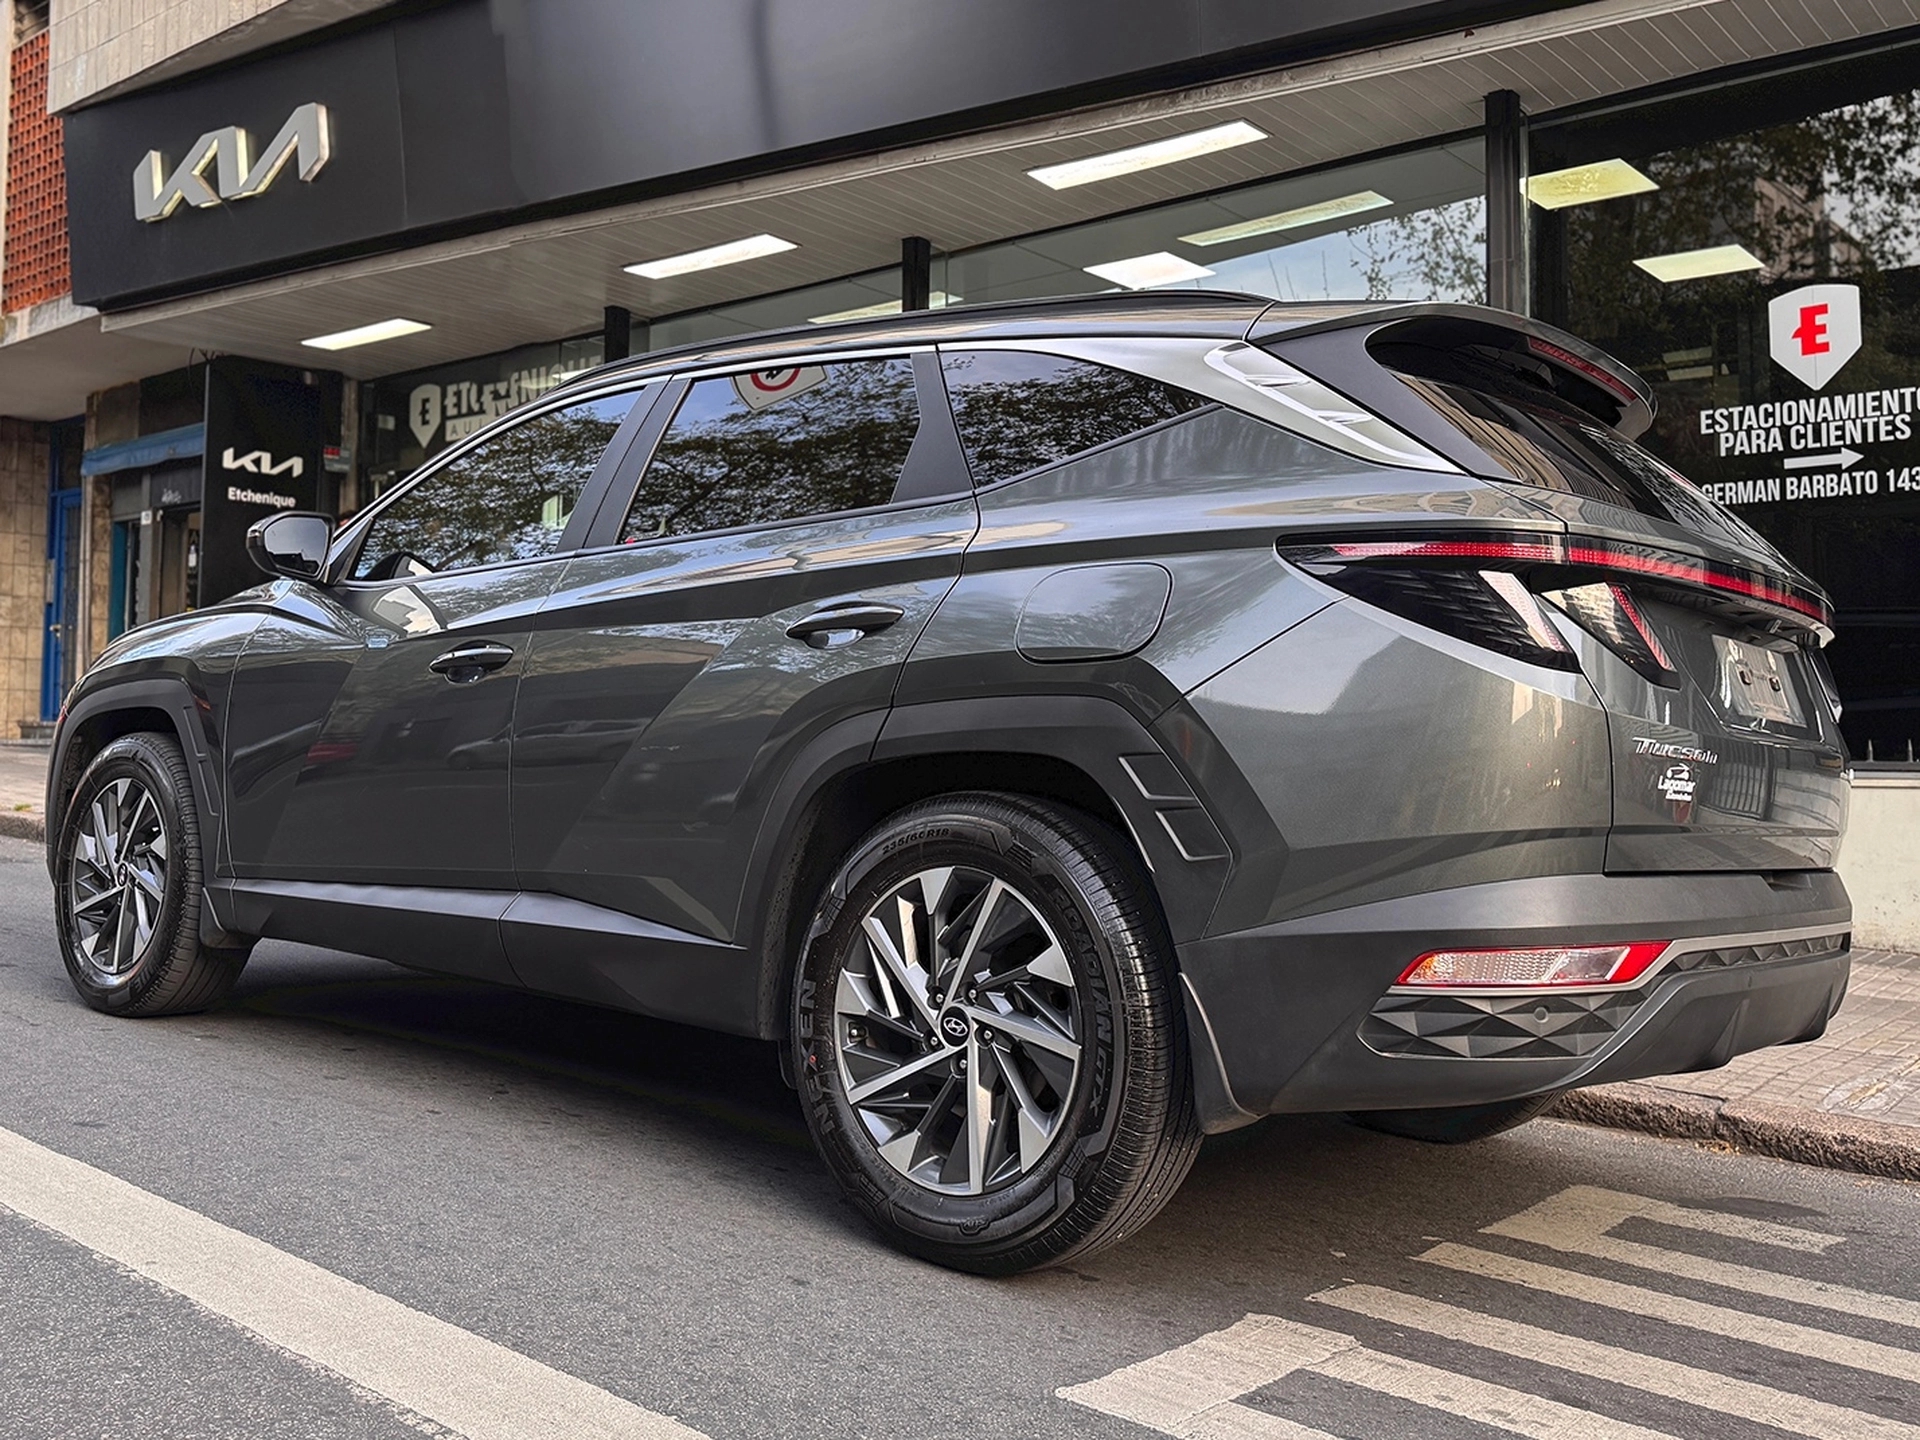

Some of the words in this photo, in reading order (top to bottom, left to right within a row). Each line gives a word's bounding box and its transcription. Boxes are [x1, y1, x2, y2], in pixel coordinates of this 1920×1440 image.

[133, 102, 330, 222] KIA
[1791, 303, 1831, 356] E
[1700, 387, 1920, 435] ESTACIONAMIENT
[1719, 427, 1784, 457] PARA
[1790, 413, 1911, 450] CLIENTES
[222, 446, 304, 479] KIA
[1786, 469, 1879, 500] BARBATO
[227, 486, 297, 508] Etchenique
[800, 979, 836, 1136] NEXEN
